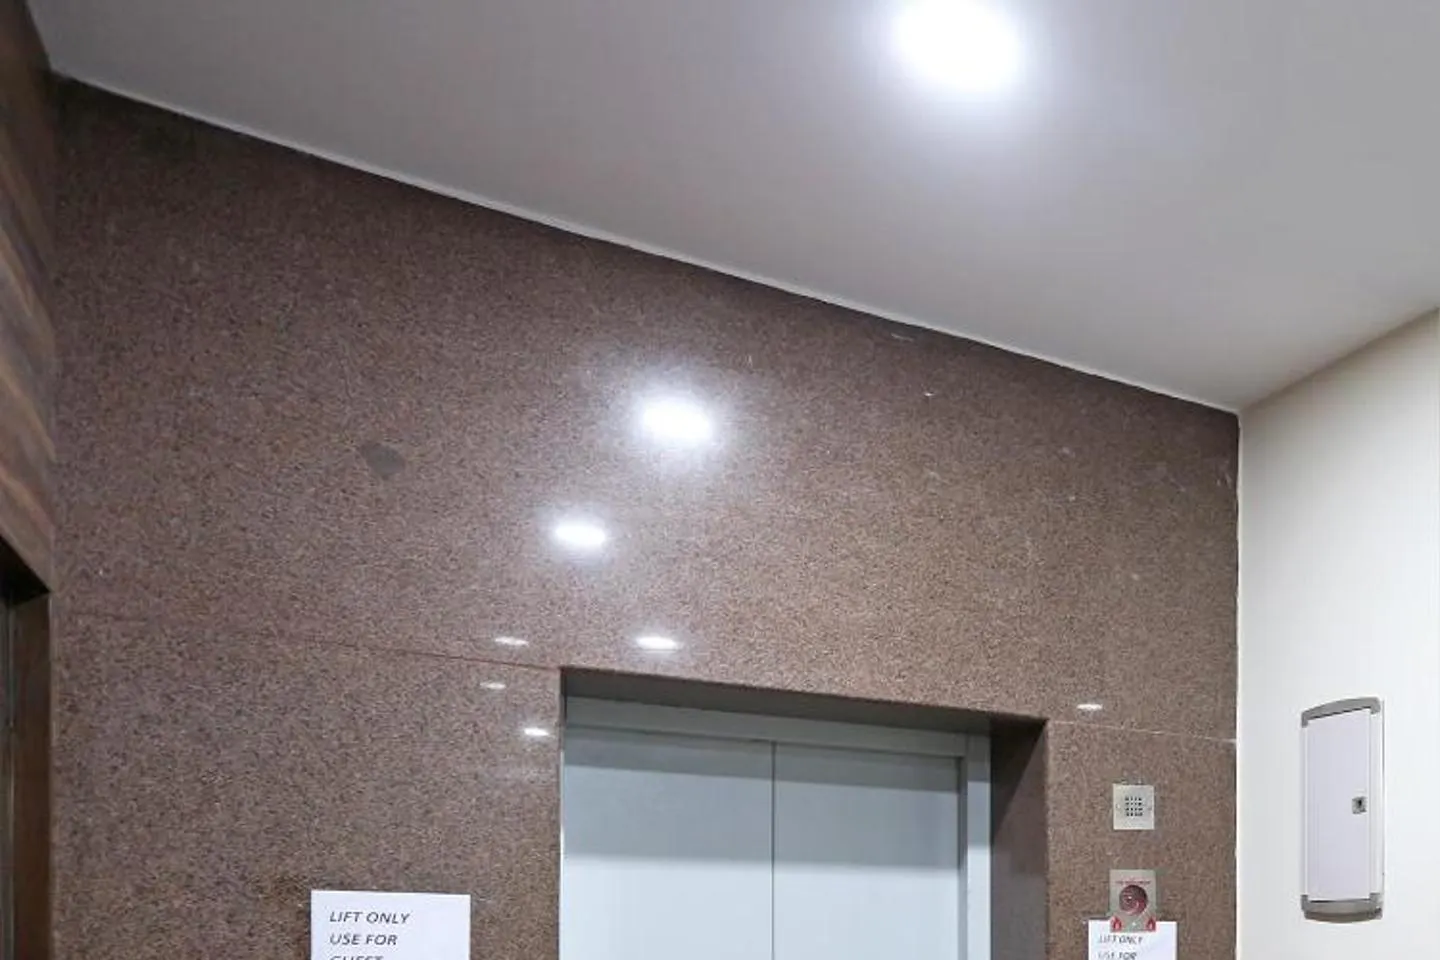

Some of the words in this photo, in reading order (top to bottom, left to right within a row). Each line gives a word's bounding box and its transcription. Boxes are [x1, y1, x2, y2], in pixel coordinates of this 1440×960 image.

[329, 911, 363, 923] LIFT
[366, 911, 411, 924] ONLY
[329, 933, 361, 946] USE
[365, 934, 398, 946] FOR
